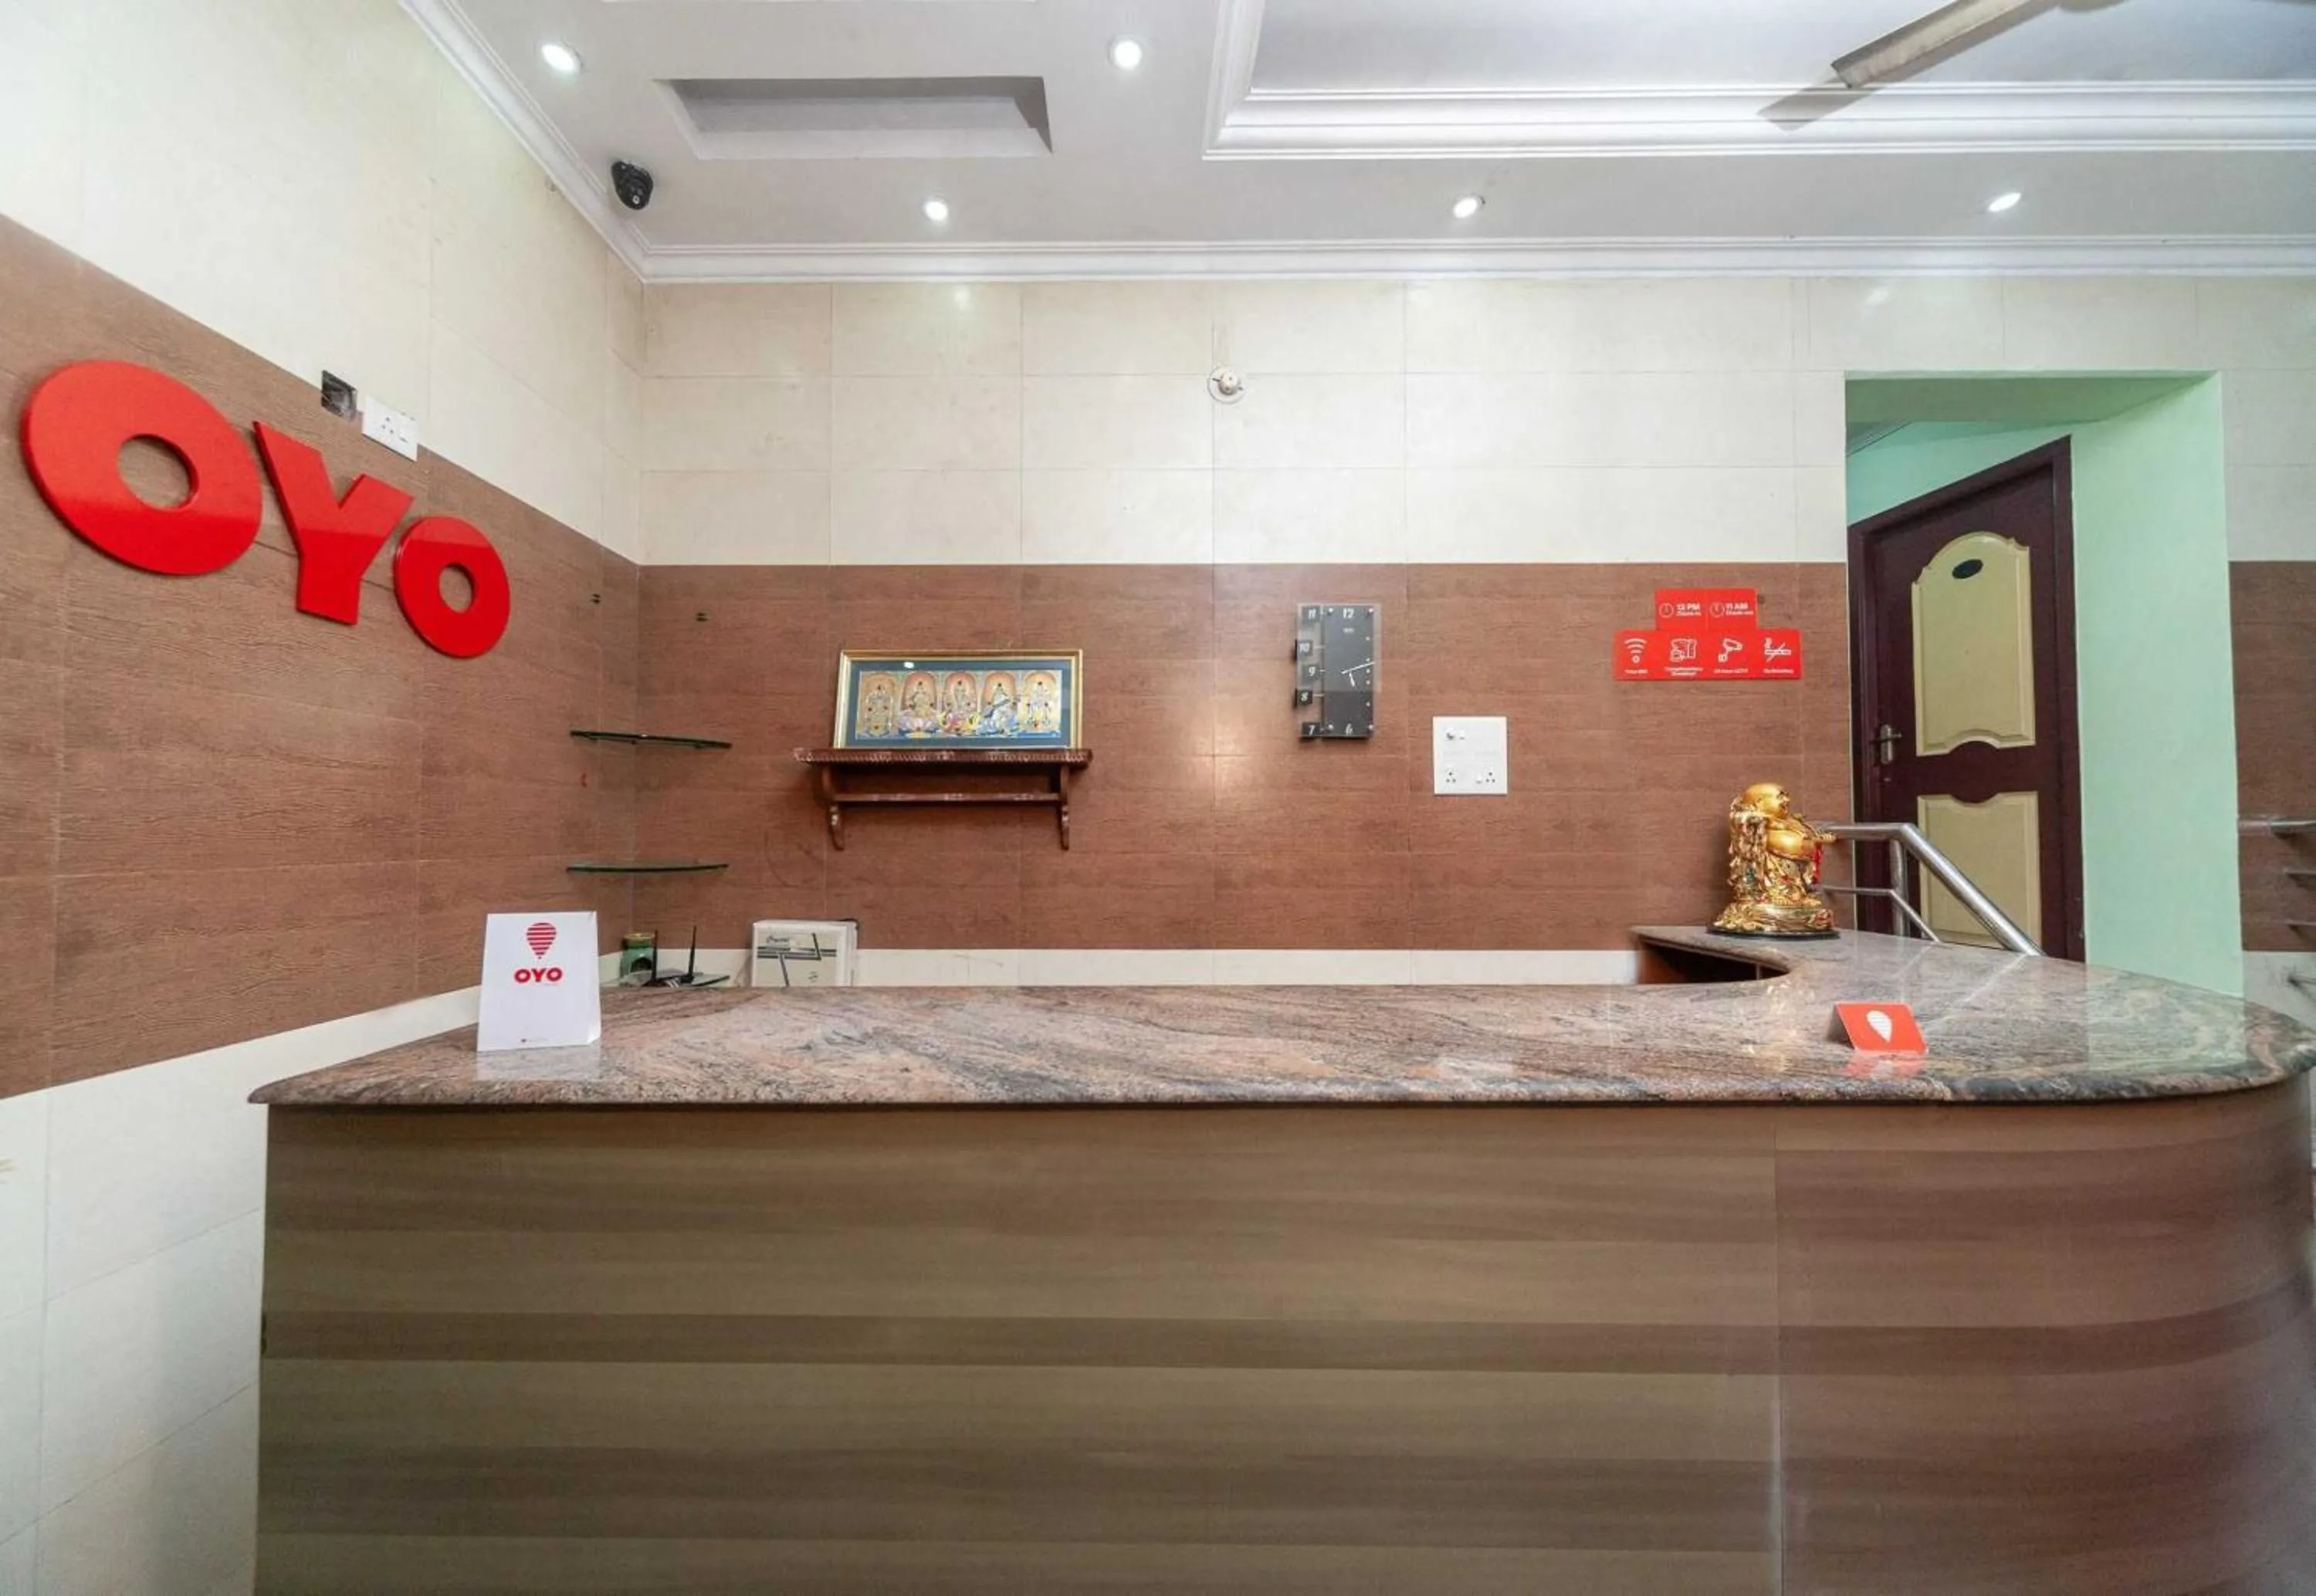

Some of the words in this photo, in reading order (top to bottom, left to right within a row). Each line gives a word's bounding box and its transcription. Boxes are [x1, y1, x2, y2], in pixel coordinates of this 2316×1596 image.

[21, 359, 510, 660] OYO
[1343, 607, 1355, 619] 12
[1299, 643, 1310, 653] 10
[1309, 666, 1316, 677] 9
[1301, 691, 1309, 702] 8
[1309, 725, 1315, 735] 7
[1346, 723, 1353, 735] 6
[514, 967, 563, 984] OYO
